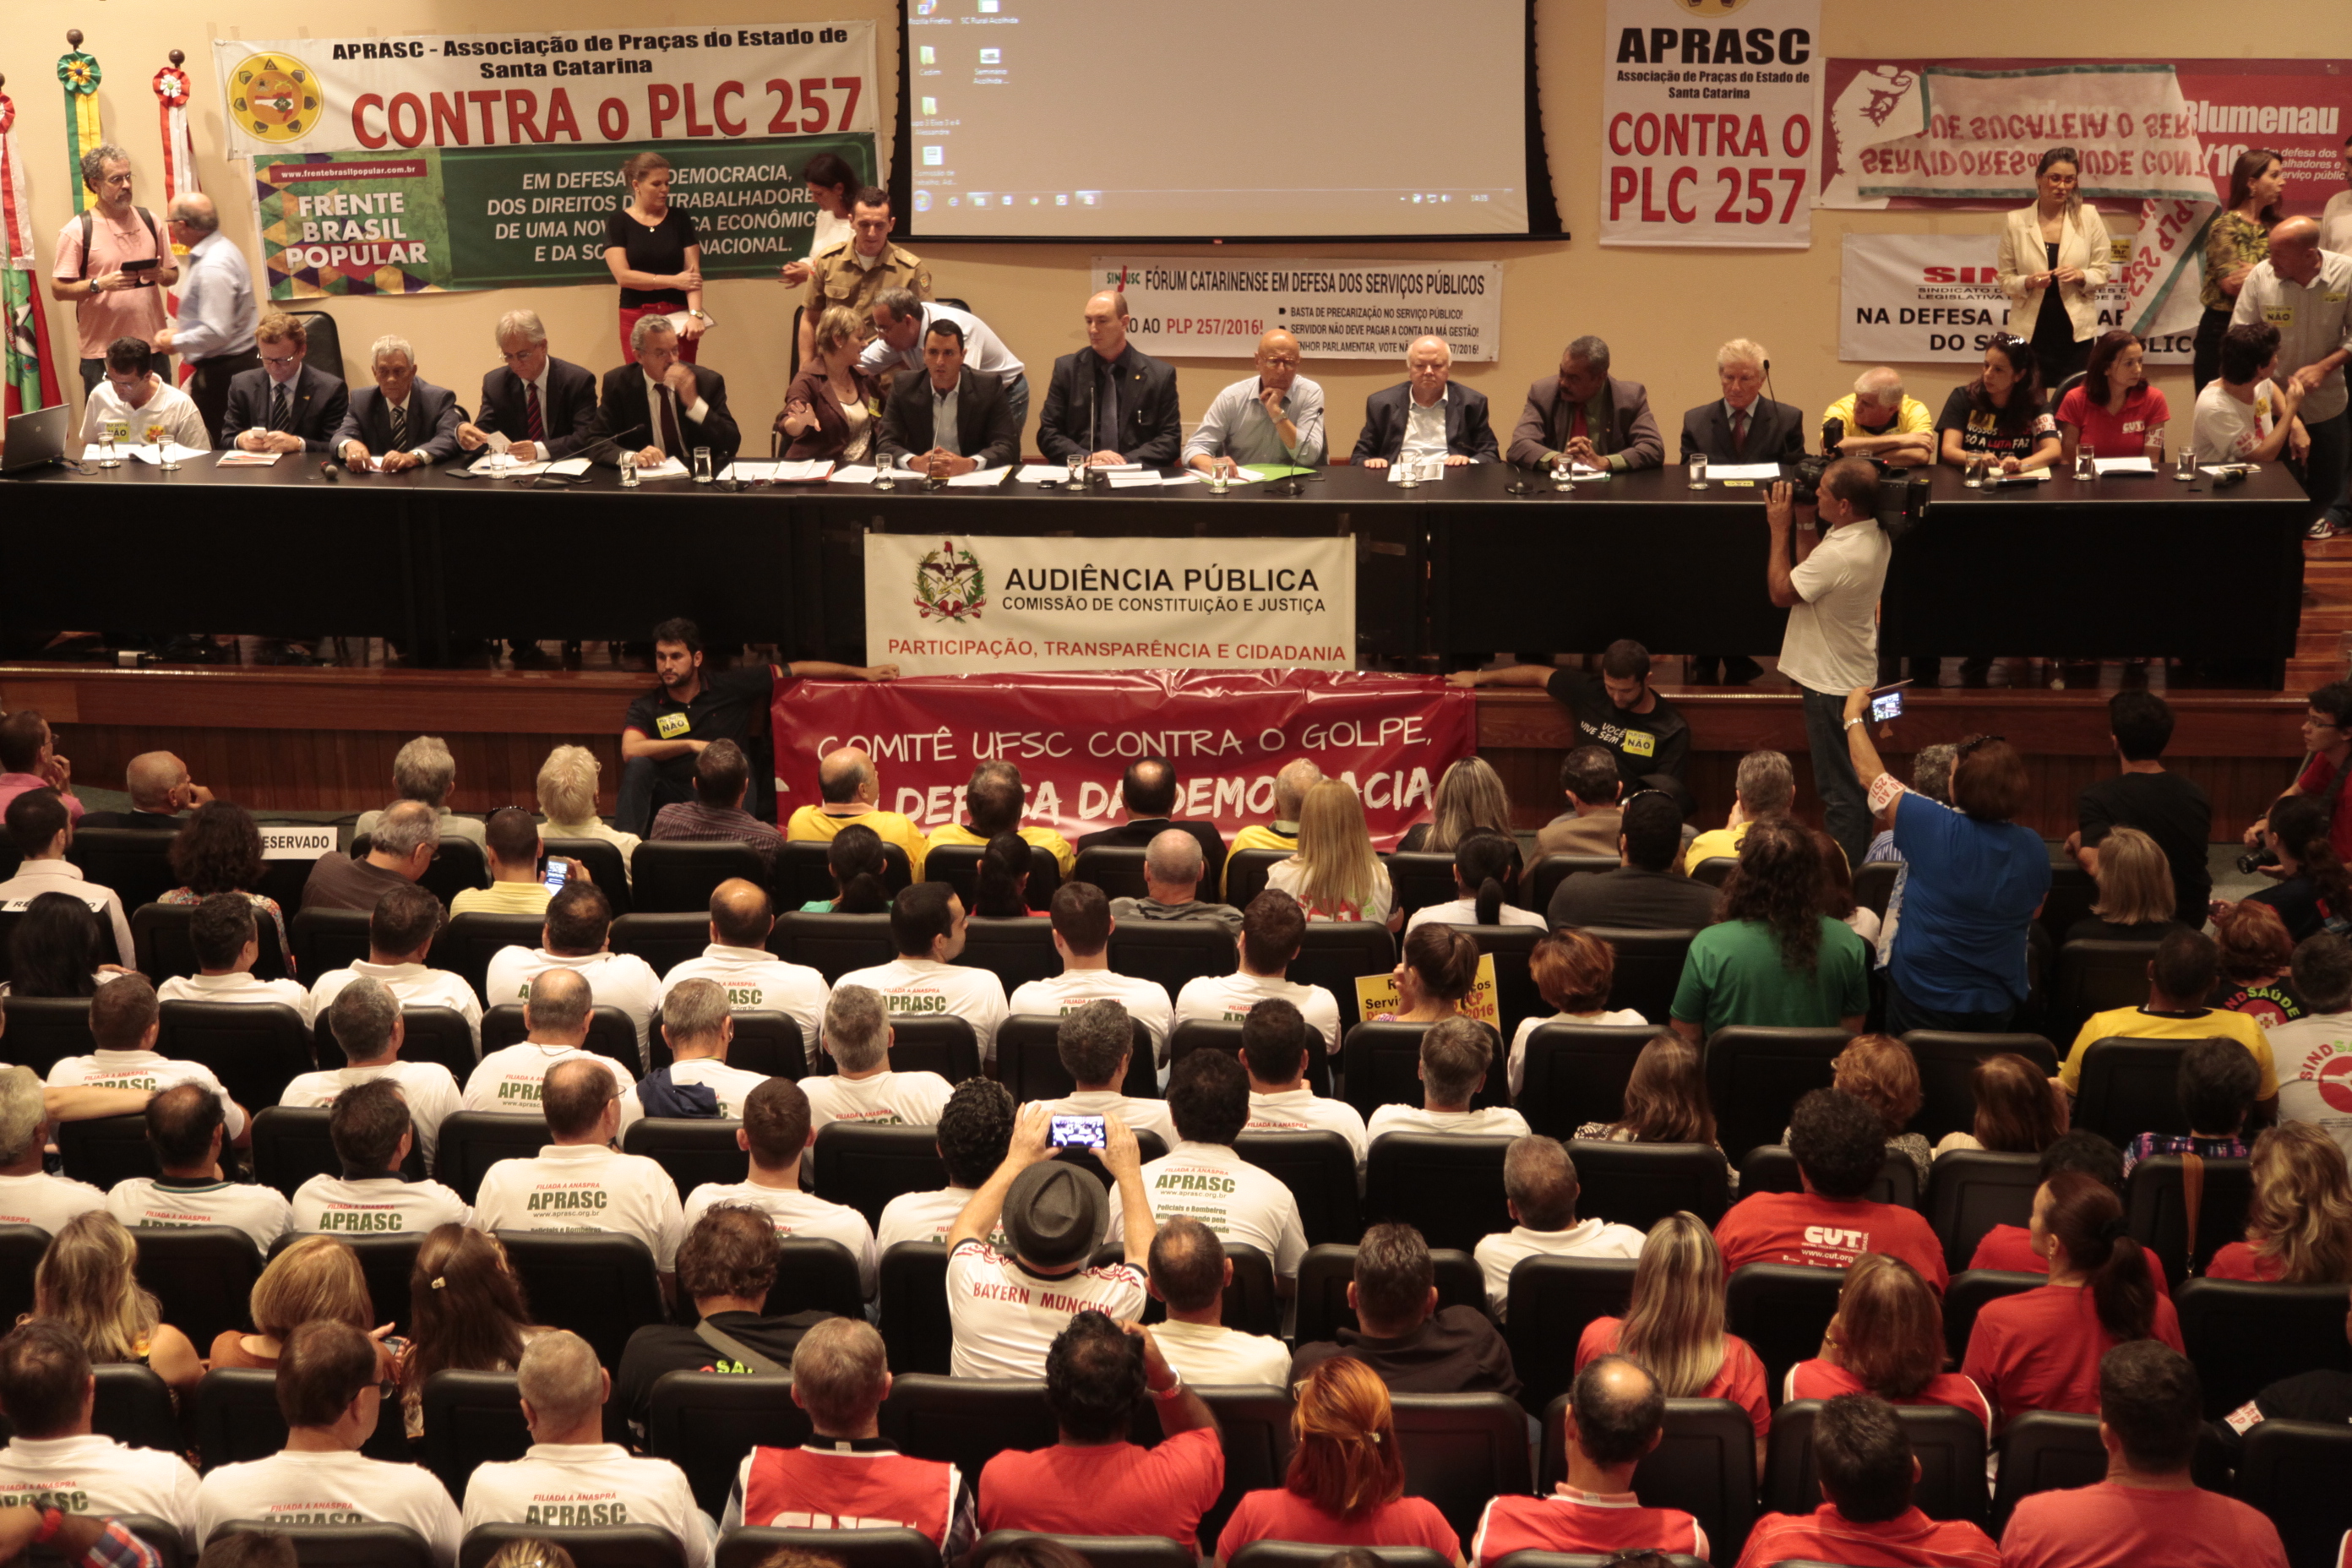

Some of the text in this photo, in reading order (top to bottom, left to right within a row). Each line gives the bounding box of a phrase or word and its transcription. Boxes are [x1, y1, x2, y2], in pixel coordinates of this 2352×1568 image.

[333, 27, 847, 60] APRASC Associação de Praças do Estado de
[1616, 28, 1810, 65] APRASC
[480, 58, 653, 79] Santa Catarina
[1617, 69, 1810, 84] Associação de Praças do Estado de
[1669, 87, 1750, 99] Santa Catarina
[351, 87, 582, 150] CONTRA
[647, 80, 748, 139] PLC
[765, 76, 862, 134] 257
[2183, 101, 2339, 134] Blumenau
[1609, 112, 1810, 158] CONTRA O
[2281, 147, 2337, 158] defesa dos
[281, 166, 416, 178] www.frentebrasilpopular.com.br
[2333, 161, 2341, 169] e
[522, 173, 551, 190] EM
[556, 171, 627, 189] DEFESA
[2314, 171, 2345, 181] públic
[298, 192, 405, 217] FRENTE
[487, 199, 526, 216] DOS
[532, 195, 617, 214] DIREITOS
[667, 188, 814, 209] TRABALHADORE
[1609, 166, 1806, 225] PLC 257
[302, 218, 407, 242] BRASIL
[495, 223, 520, 240] DE
[525, 220, 569, 238] UMA
[717, 209, 818, 231] ECONÔMIC
[286, 242, 428, 269] POPULAR
[535, 246, 546, 262] E
[551, 245, 577, 261] DA
[1146, 265, 1187, 291] FÓRUM
[1190, 270, 1269, 291] CATARINENSE
[1271, 272, 1288, 291] EM
[1292, 272, 1336, 293] DEFESA
[1339, 273, 1363, 293] DOS
[1366, 273, 1424, 300] SERVIÇOS
[1426, 270, 1484, 295] PÚBLICOS
[1291, 305, 1463, 321] BASTA DE PRECARIZAÇÃO NO SERVIÇO PÚBLICO!
[1857, 308, 1993, 325] NA DEFESA
[1142, 318, 1161, 334] AO
[1167, 318, 1193, 334] PLP
[1196, 318, 1264, 336] 257/2016!
[1291, 322, 1479, 338] SERVIDOR NÃO DEVE PAGAR A CONTA DA MÁ GESTÃO!
[1322, 341, 1397, 354] PARLAMENTAR, VOTE
[1930, 334, 1965, 351] DO
[1979, 437, 1986, 447] A
[1987, 439, 2012, 449] LUTA
[2012, 438, 2030, 449] FAZ
[1004, 564, 1319, 592] AUDIÊNCIA PÚBLICA
[1003, 595, 1326, 615] COMISSÃO DE CONSTITUIÇÃO E JUSTIÇA
[889, 638, 1346, 661] PARTICIPAÇÃO, TRANSPARÊNCIA E CIDADANIA
[817, 716, 1432, 763] COMITÊ UFSC CONTRA O GOLPE,
[1580, 721, 1620, 744] VIVE SEM
[1627, 738, 1651, 749] NÃO
[263, 836, 329, 849] ESERVADO
[2224, 987, 2300, 1019] NDSAÚDE
[1155, 1174, 1235, 1194] APRASC
[527, 1191, 607, 1211] APRASC
[1160, 1190, 1227, 1200] www.aprasc.org.br
[145, 1211, 211, 1222] FILIADA ANASPRA
[533, 1210, 600, 1219] www.aprasc.org.br
[1157, 1204, 1227, 1215] Policiais Bombeiros
[319, 1212, 403, 1231] APRASC
[1805, 1226, 1862, 1249] CUT
[1801, 1250, 1854, 1263] www.cut.org
[973, 1282, 1031, 1305] BAYERN
[533, 1493, 617, 1502] FILIADA ANASPRA
[270, 1502, 353, 1513] FILIADA ANASPRA
[525, 1503, 626, 1526] APRASC
